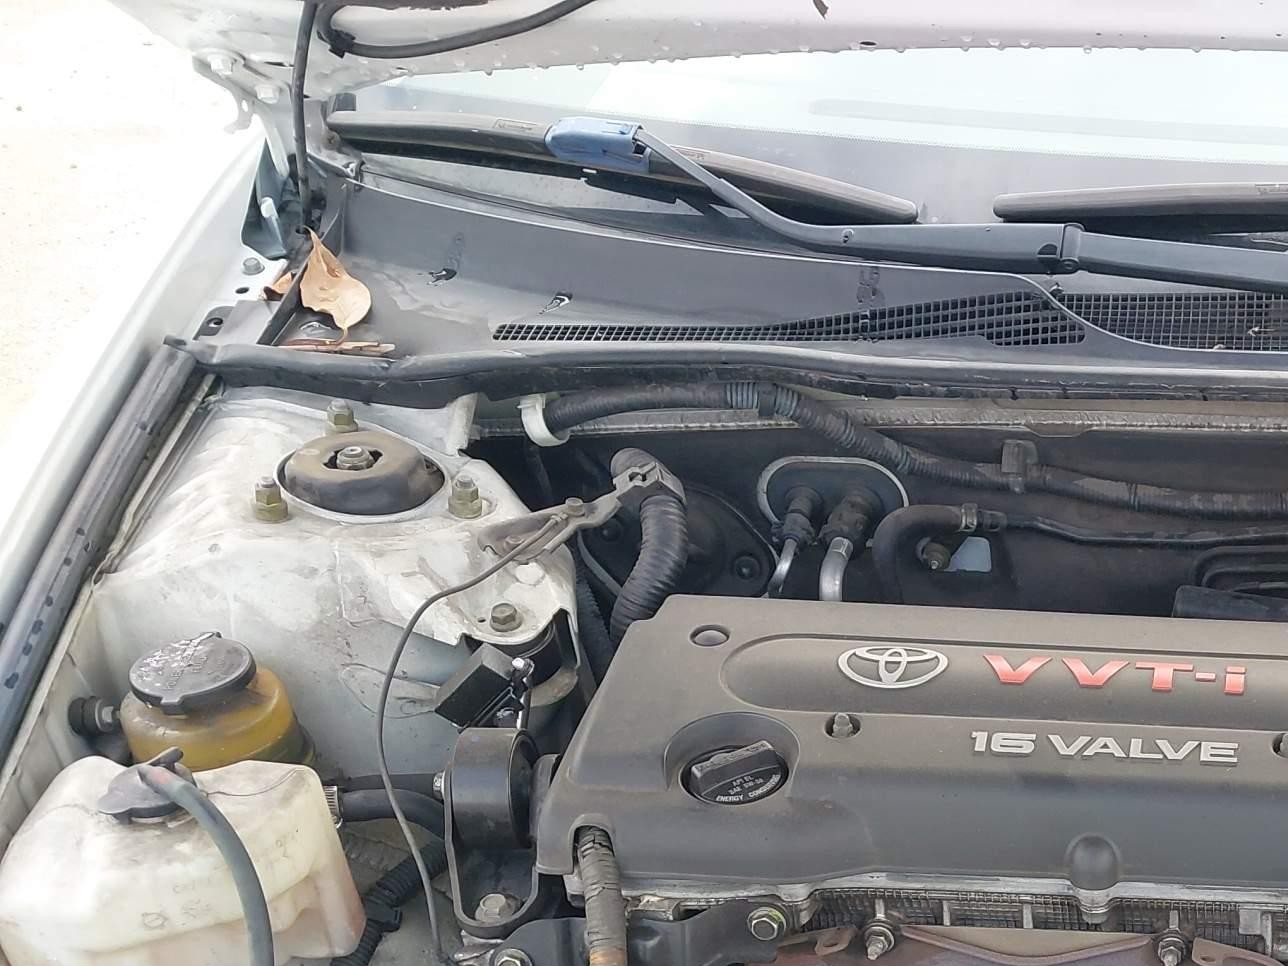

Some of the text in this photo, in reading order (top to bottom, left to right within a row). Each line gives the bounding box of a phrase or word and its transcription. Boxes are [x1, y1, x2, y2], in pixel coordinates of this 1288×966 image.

[983, 655, 1247, 694] VVT-i
[972, 731, 1240, 765] 16 VALVE
[716, 794, 744, 802] ENERGY
